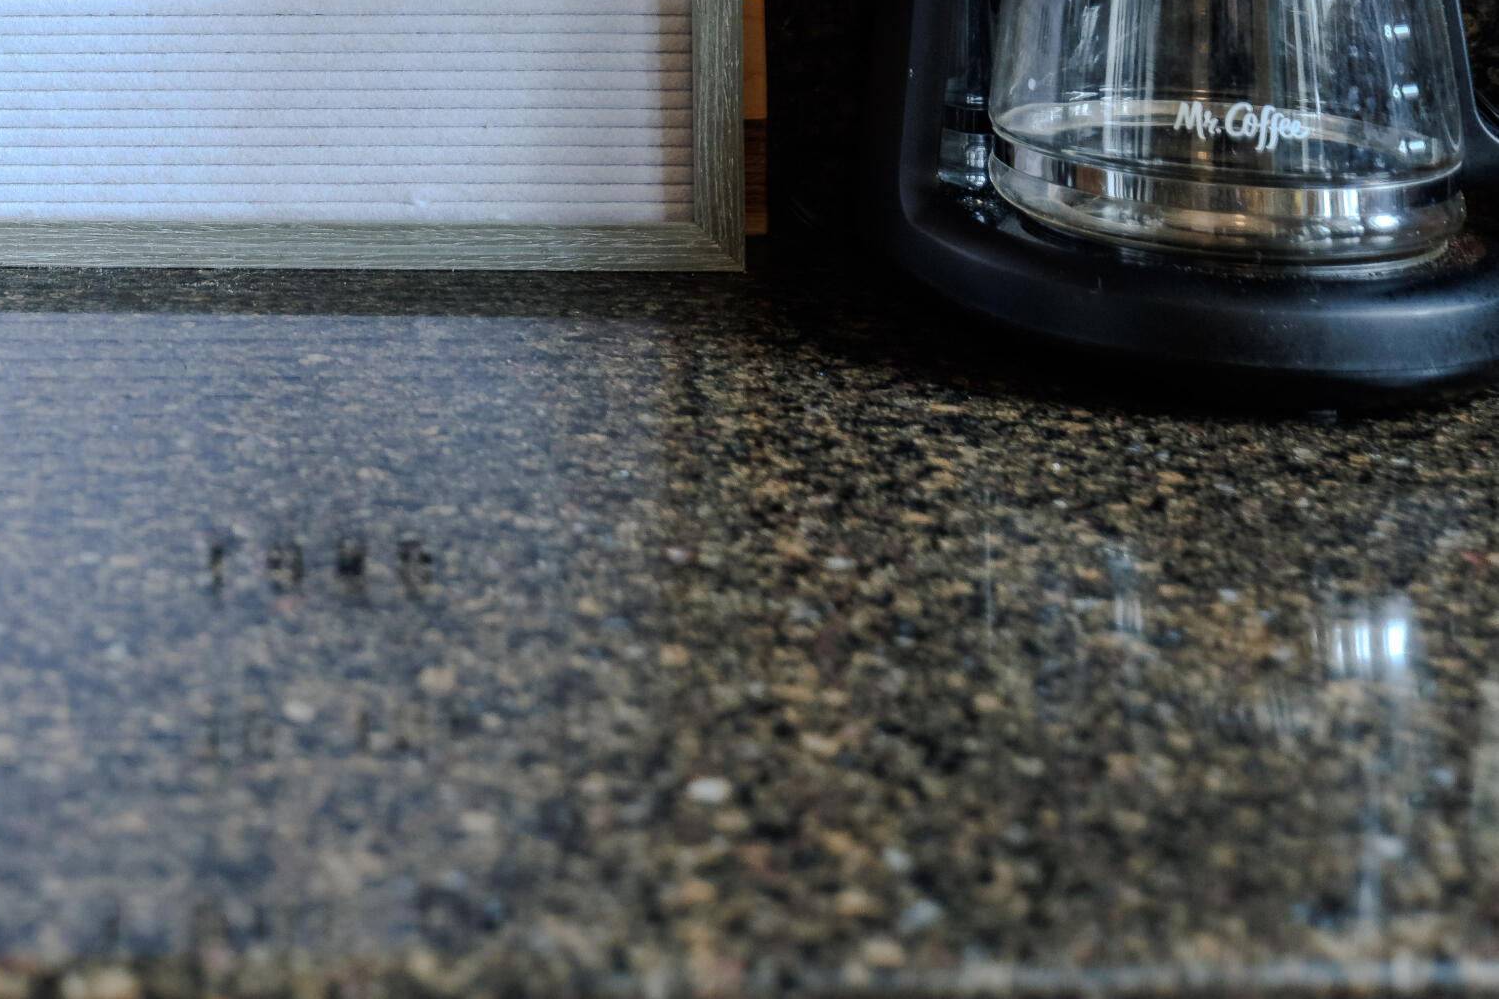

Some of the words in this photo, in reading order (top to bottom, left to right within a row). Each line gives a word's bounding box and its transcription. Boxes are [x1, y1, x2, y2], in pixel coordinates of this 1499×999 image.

[1384, 23, 1393, 39] 8
[1393, 83, 1402, 99] 6
[1174, 101, 1221, 140] Mr.
[1225, 102, 1309, 150] Coffee
